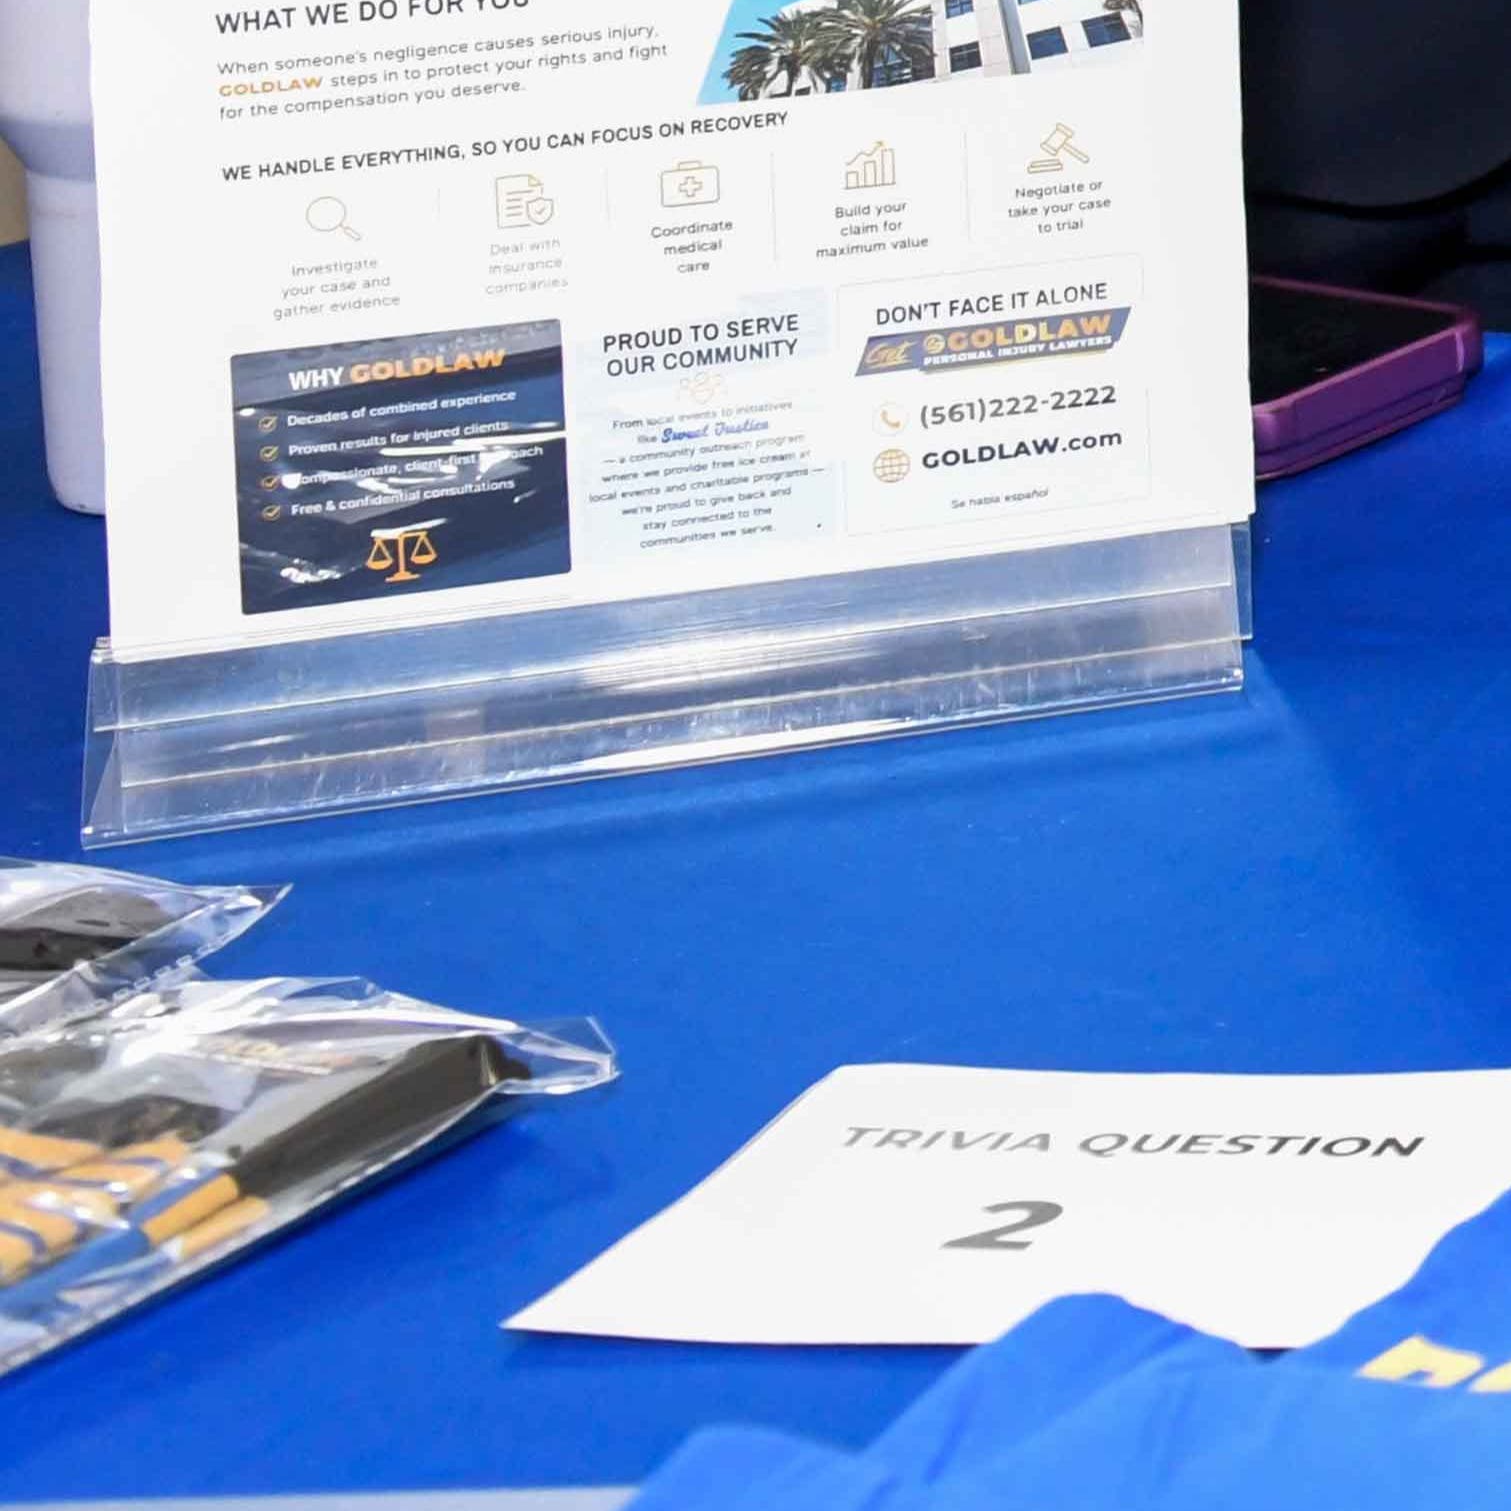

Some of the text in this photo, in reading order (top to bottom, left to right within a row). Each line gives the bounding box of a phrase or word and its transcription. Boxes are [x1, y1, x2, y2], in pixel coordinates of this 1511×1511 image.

[215, 7, 297, 34] WHAT
[305, 2, 349, 26] WE
[216, 25, 659, 75] When someone's negligence causes serious injury,
[218, 44, 668, 98] GOLDLAW steps in to protect your rights and fight
[222, 111, 788, 181] WE HANDLE EVERYTHING, SO YOU CAN FOCUS ON RECOVERY
[876, 282, 1107, 326] DON'T FACE IT ALONE
[603, 313, 799, 353] PROUD TO SERVE
[288, 349, 506, 390] WHY GOLDLAW
[607, 338, 798, 377] OUR COMMUNITY
[920, 385, 1117, 429] (561)222-2222
[922, 432, 1123, 469] GOLDLAW.com
[840, 1124, 1427, 1161] TRIVIA QUESTION
[938, 1199, 1065, 1252] 2
